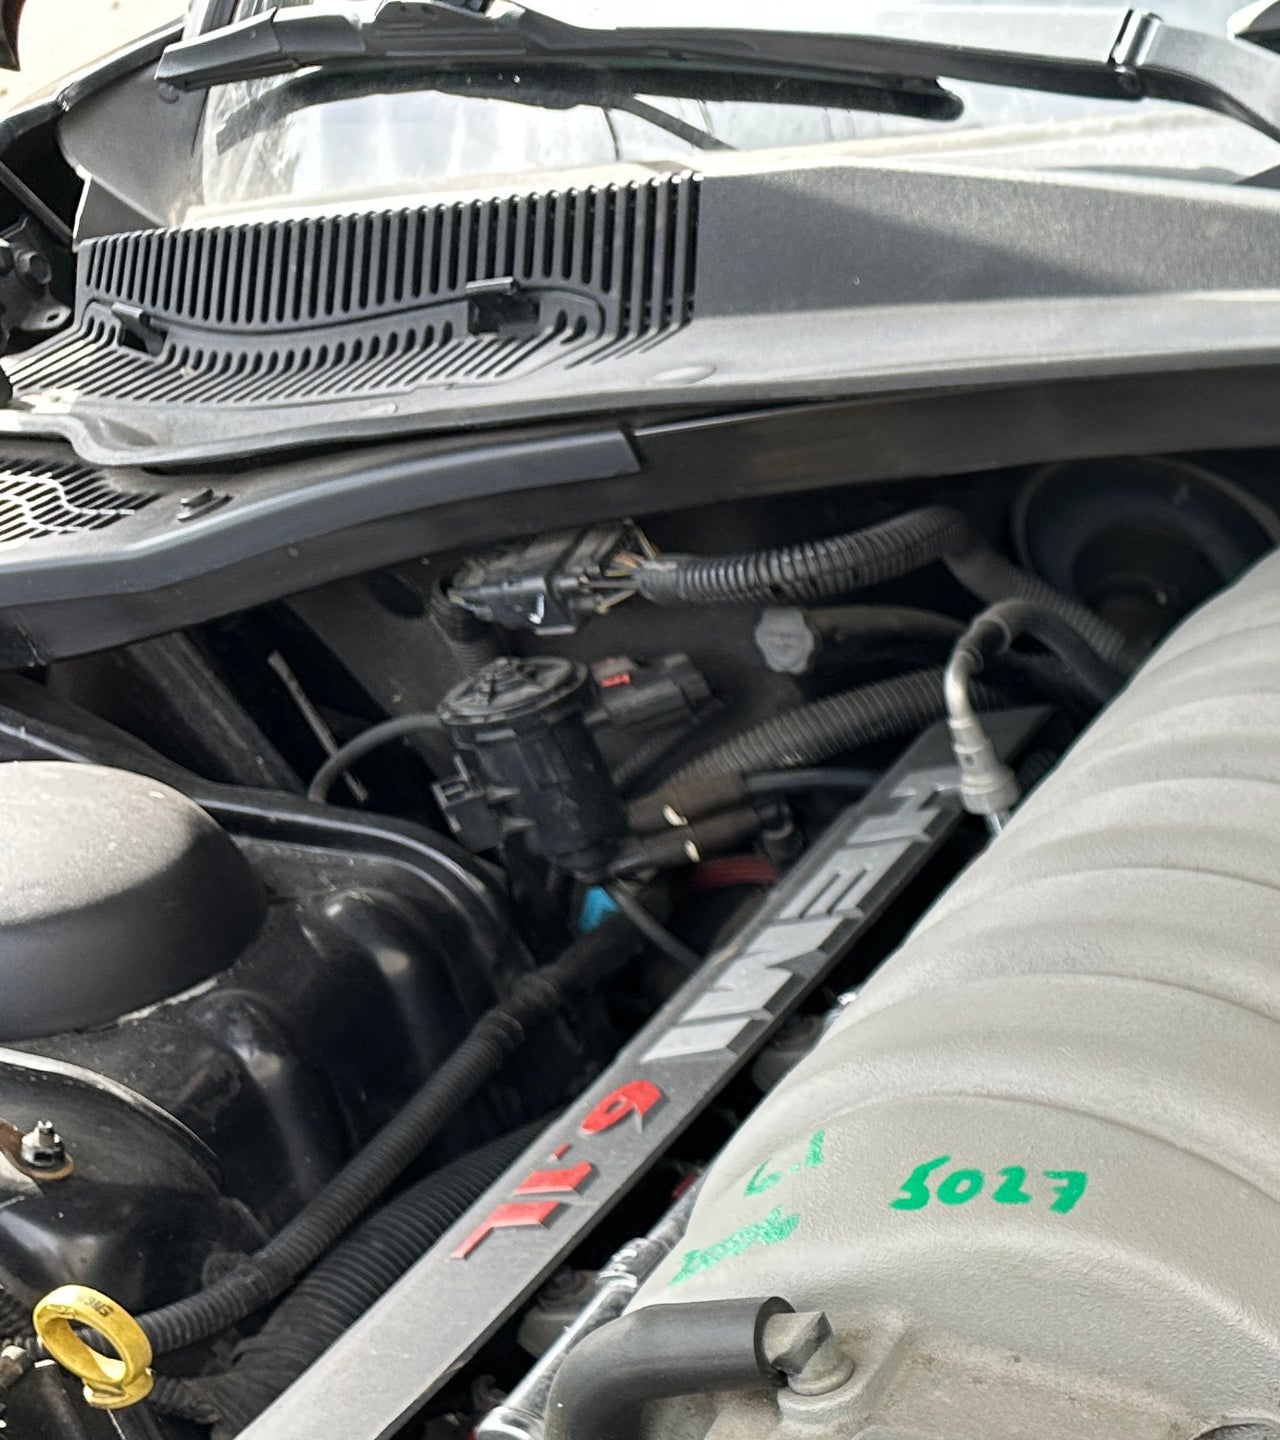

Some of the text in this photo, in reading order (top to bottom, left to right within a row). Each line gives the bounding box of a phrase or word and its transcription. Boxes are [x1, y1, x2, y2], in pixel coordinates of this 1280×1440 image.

[636, 767, 968, 1065] HEMI
[451, 1080, 663, 1260] 6.1L
[889, 1154, 1089, 1215] 5027
